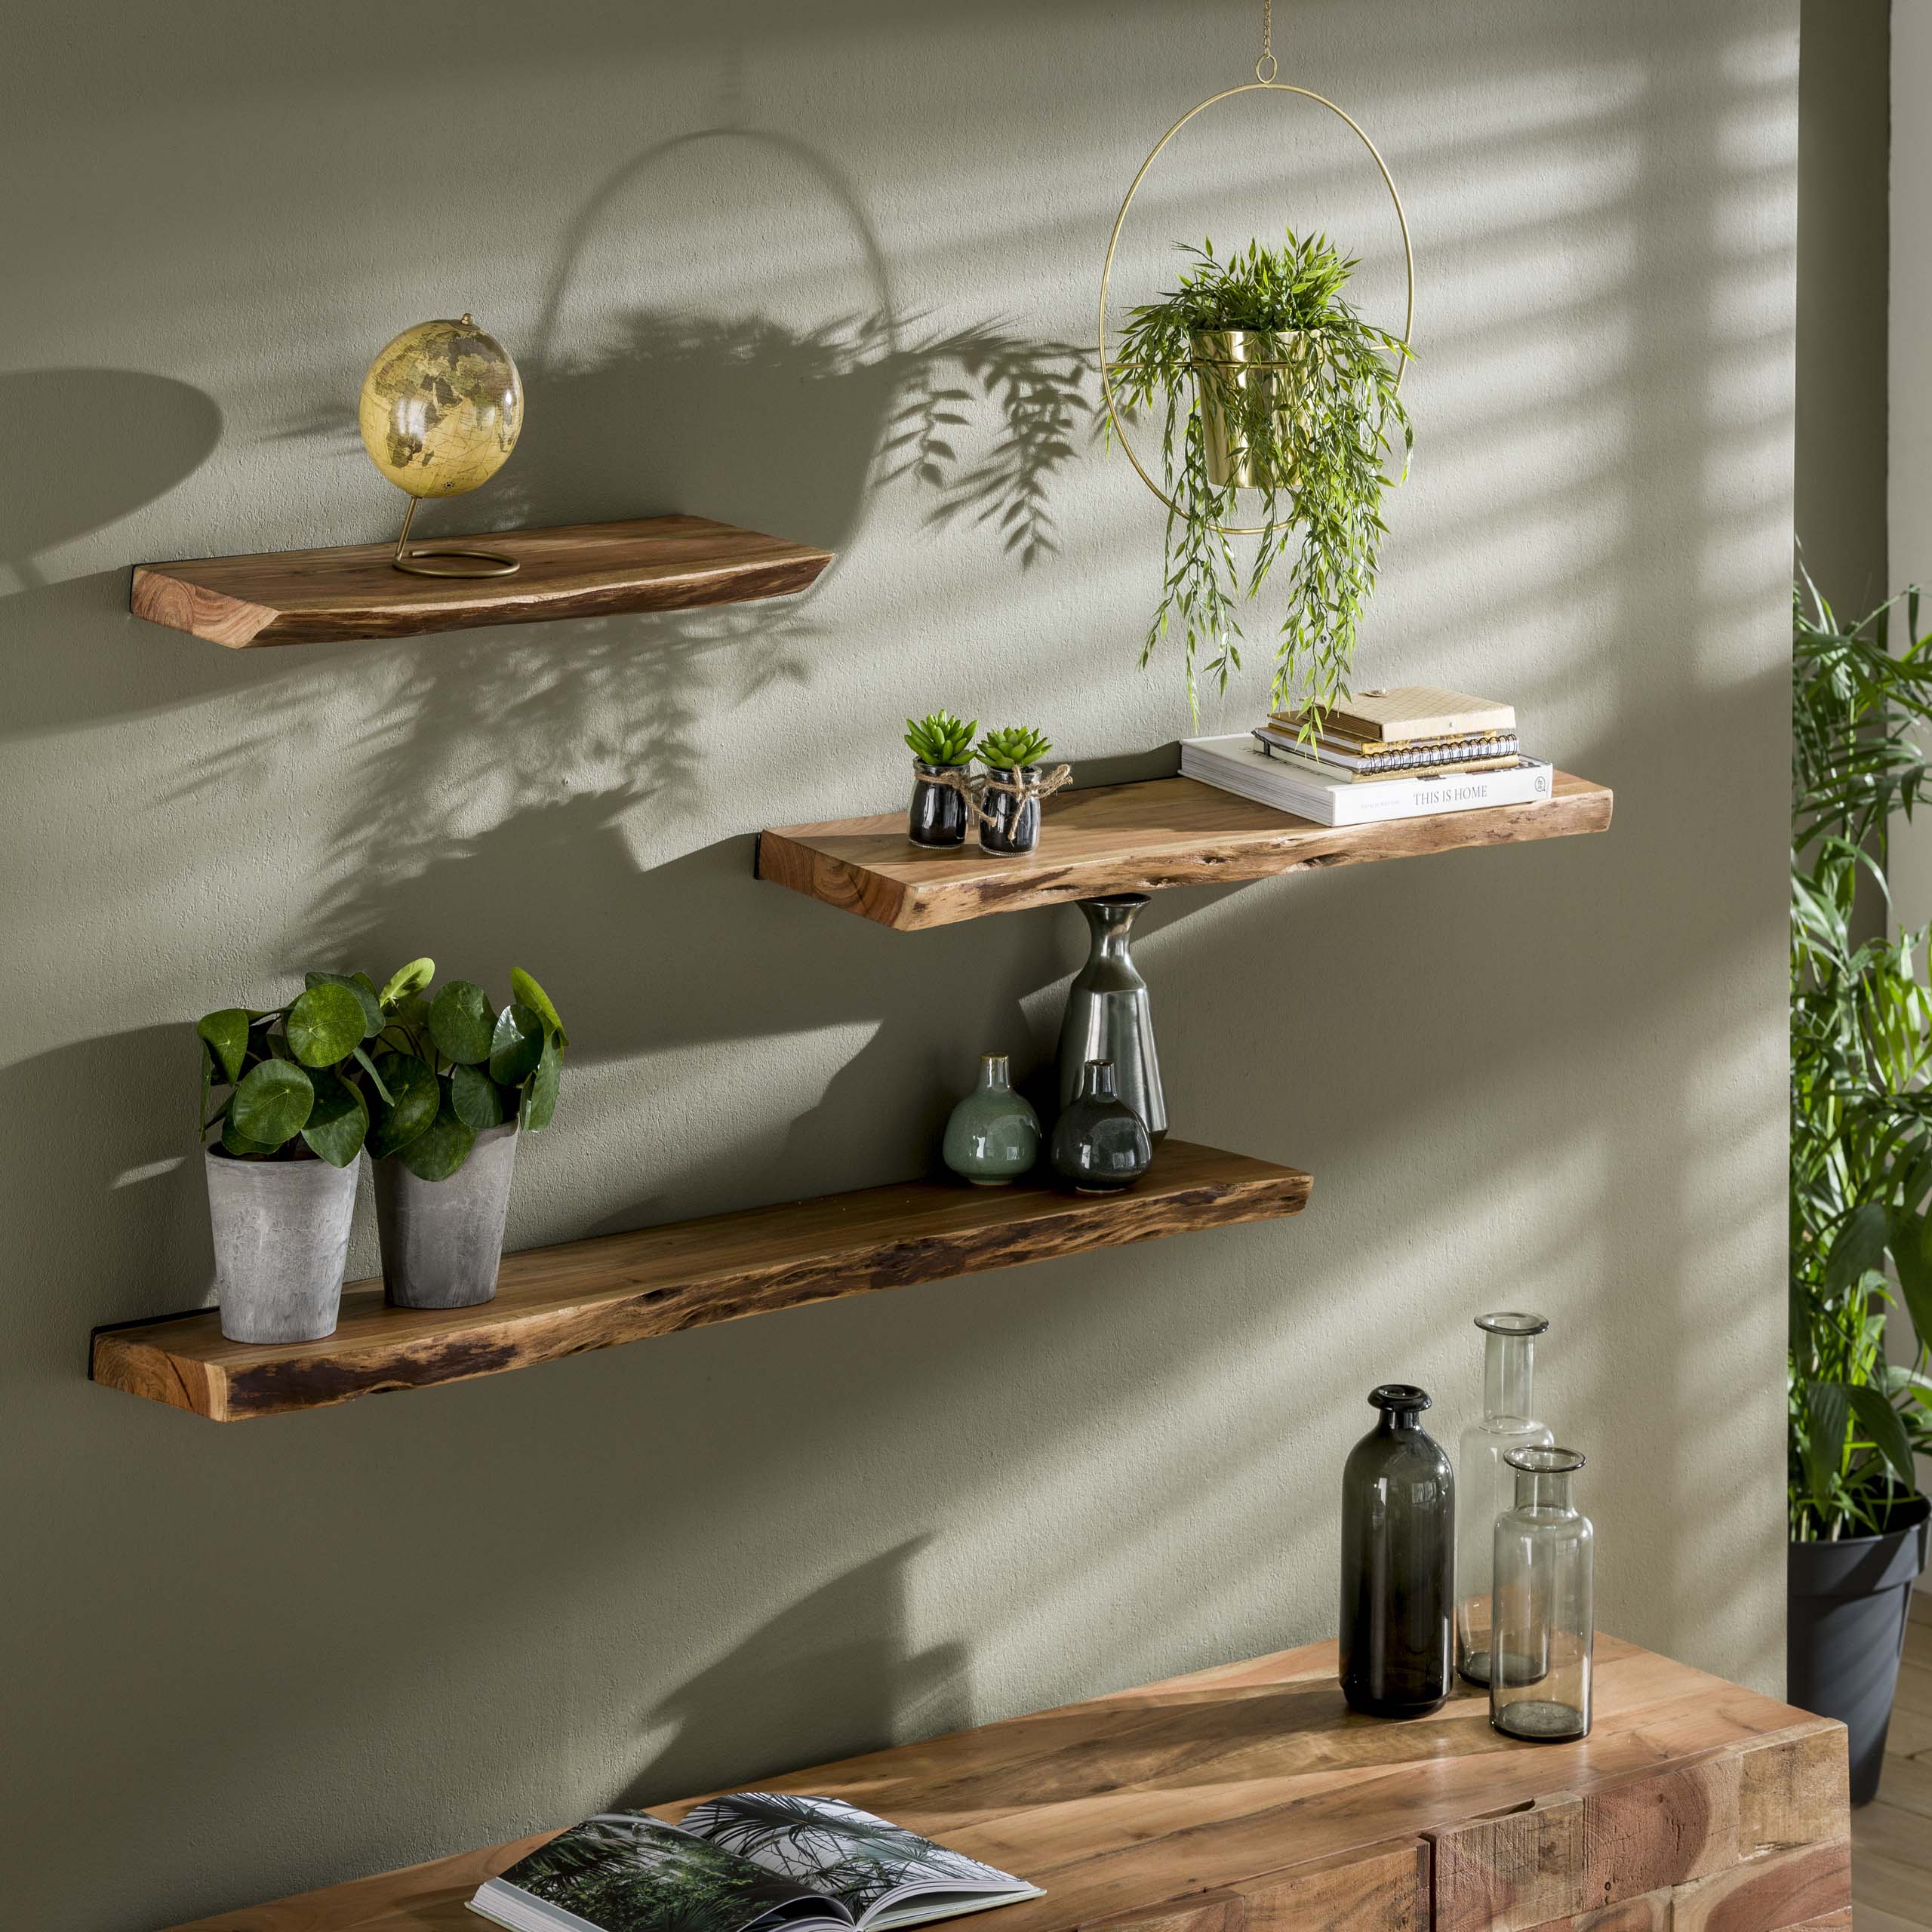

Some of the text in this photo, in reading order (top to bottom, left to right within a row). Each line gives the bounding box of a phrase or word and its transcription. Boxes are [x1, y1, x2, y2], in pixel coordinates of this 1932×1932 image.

[1414, 791, 1438, 805] THIS
[1442, 789, 1451, 802] IS
[1454, 785, 1487, 801] HOME
